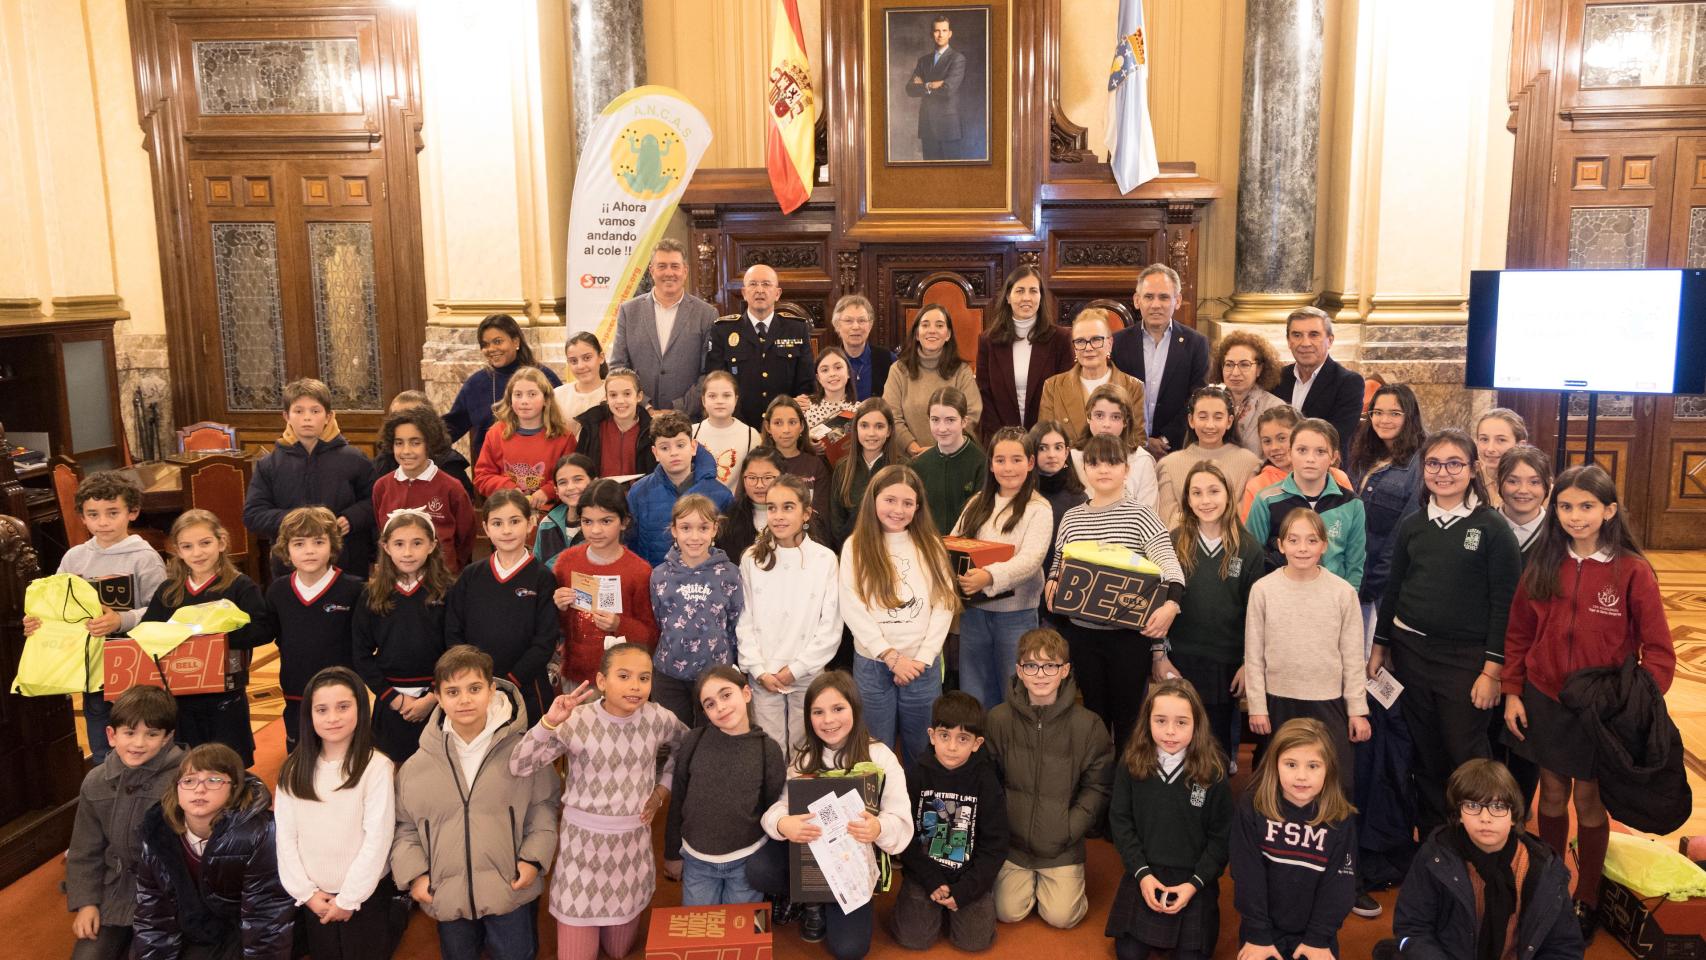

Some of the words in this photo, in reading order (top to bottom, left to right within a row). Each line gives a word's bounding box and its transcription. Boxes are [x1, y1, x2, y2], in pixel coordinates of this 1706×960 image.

[612, 201, 647, 212] Ahora
[599, 218, 636, 226] vamos
[587, 231, 637, 241] andando
[584, 245, 594, 255] al
[597, 245, 622, 255] cole
[580, 273, 610, 288] STOP
[175, 661, 200, 669] BELL
[1265, 819, 1328, 852] FSM
[668, 914, 689, 937] LIVE
[687, 912, 708, 938] WIDE
